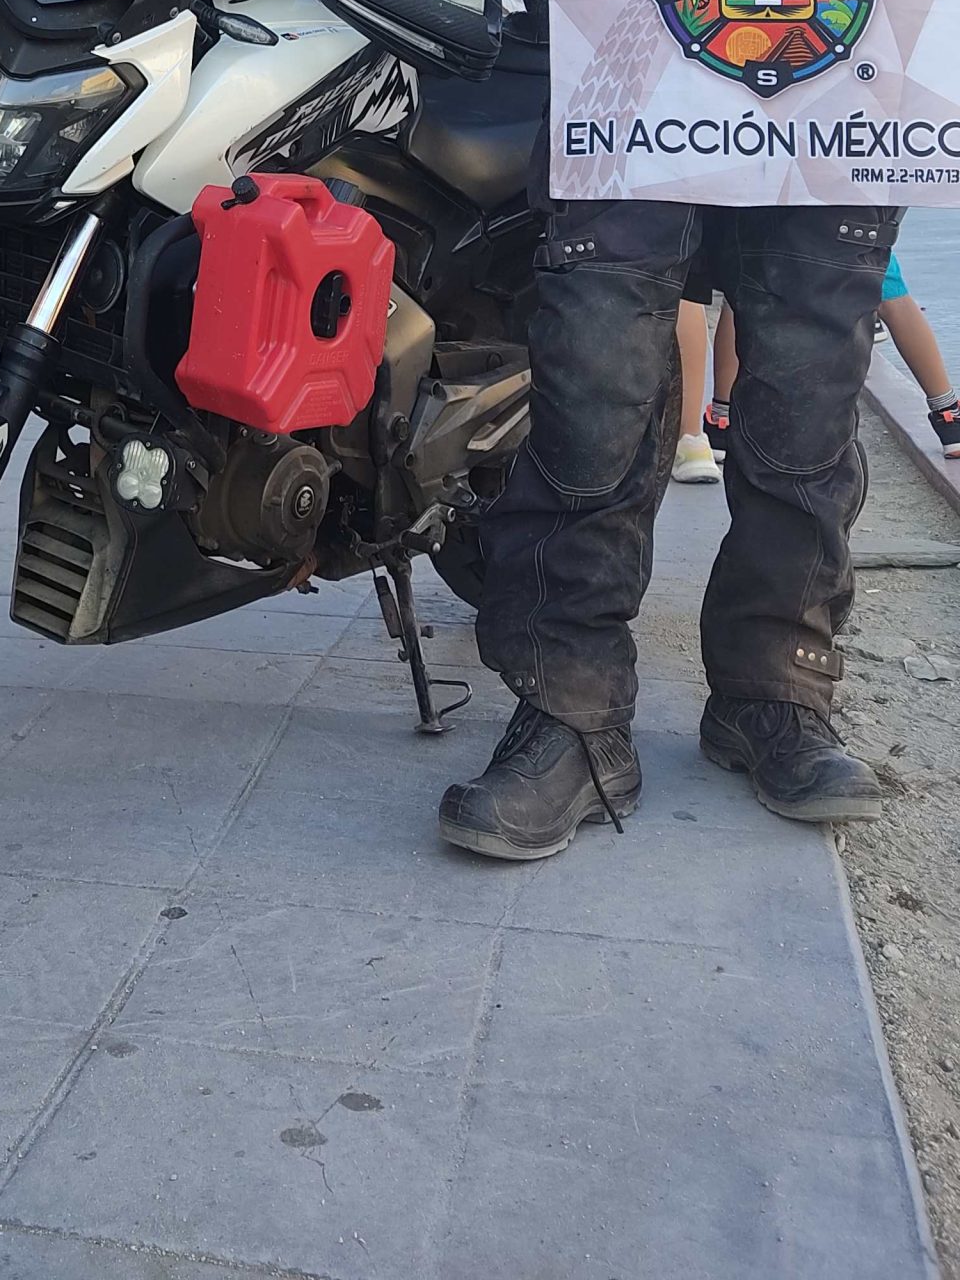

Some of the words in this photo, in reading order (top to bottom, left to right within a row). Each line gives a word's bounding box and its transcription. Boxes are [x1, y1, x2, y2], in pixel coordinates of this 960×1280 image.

[756, 69, 778, 86] S
[566, 120, 615, 156] EN
[625, 111, 794, 157] ACCIÓN
[809, 110, 960, 158] MÉXICO
[851, 168, 884, 183] RRM
[886, 168, 960, 184] 2.2-RA713
